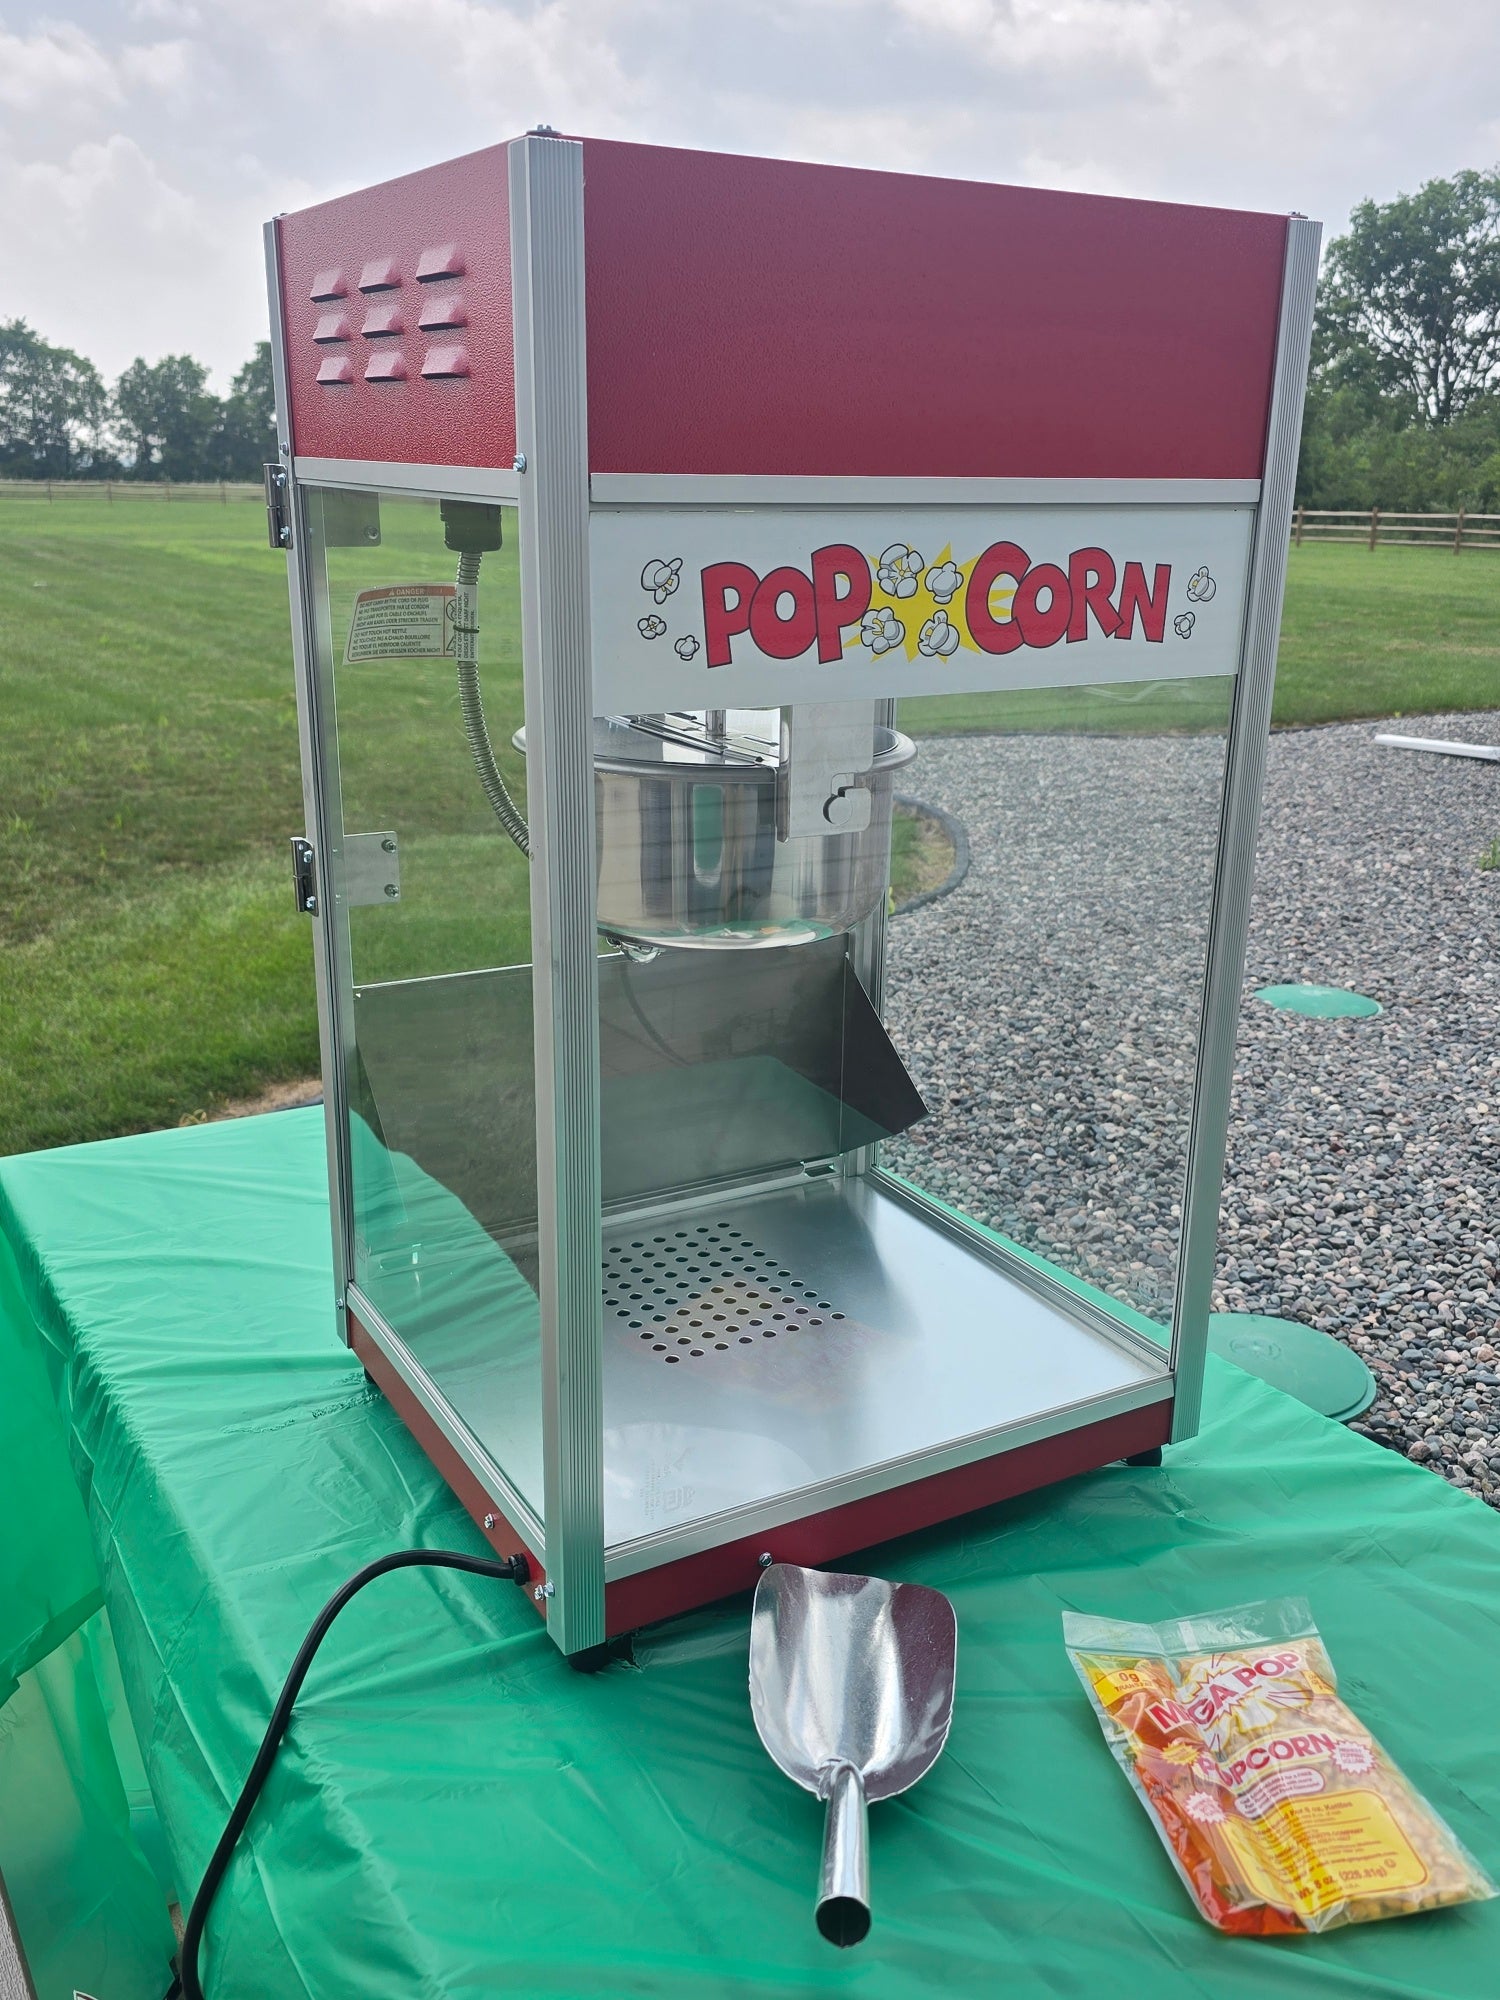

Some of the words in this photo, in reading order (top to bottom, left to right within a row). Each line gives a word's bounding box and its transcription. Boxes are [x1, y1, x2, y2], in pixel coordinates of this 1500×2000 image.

[370, 604, 396, 612] TRANSPORTER
[701, 544, 872, 668] POP
[965, 541, 1171, 655] CORN
[1119, 1672, 1140, 1683] 0g
[1149, 1683, 1238, 1729] MGA
[1232, 1652, 1301, 1688] POP
